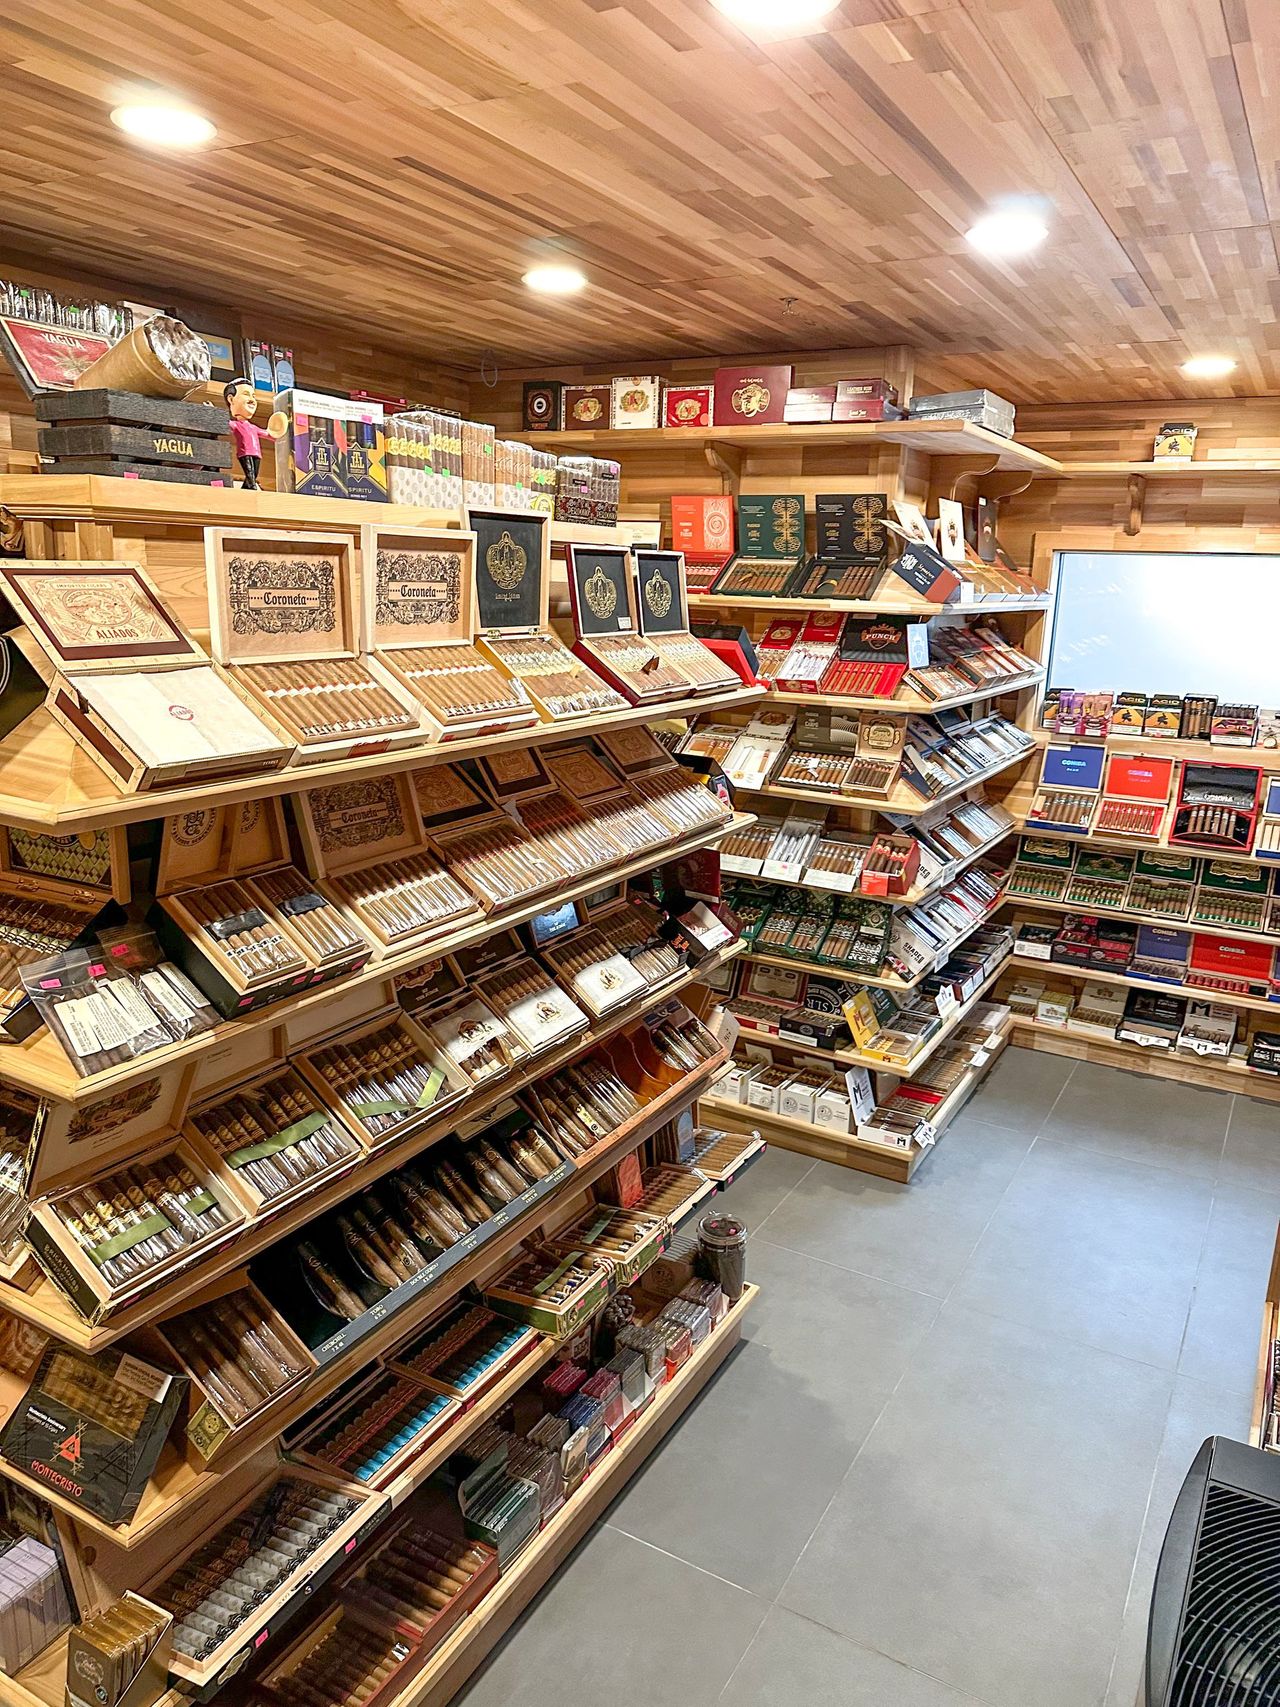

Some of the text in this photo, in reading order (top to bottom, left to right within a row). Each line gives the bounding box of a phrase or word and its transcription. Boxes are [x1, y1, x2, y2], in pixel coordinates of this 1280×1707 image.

[41, 332, 85, 351] YAGUA
[153, 438, 194, 458] YAGUA
[311, 484, 336, 492] ESPIRITU
[263, 588, 307, 606] Coroneta
[400, 584, 437, 598] Coroneta
[96, 628, 139, 639] ALIADOS
[865, 633, 896, 641] PUNCH
[1119, 696, 1146, 704] ACID
[341, 808, 379, 824] Coroneta
[1152, 928, 1178, 937] COHIBA
[1218, 945, 1246, 954] COHIBA
[807, 998, 829, 1011] SLR
[41, 1241, 82, 1293] BRICK HOUSE
[370, 1304, 384, 1316] TORO
[321, 1333, 347, 1352] CHURCHILL
[31, 1460, 82, 1497] MONTECRISTO
